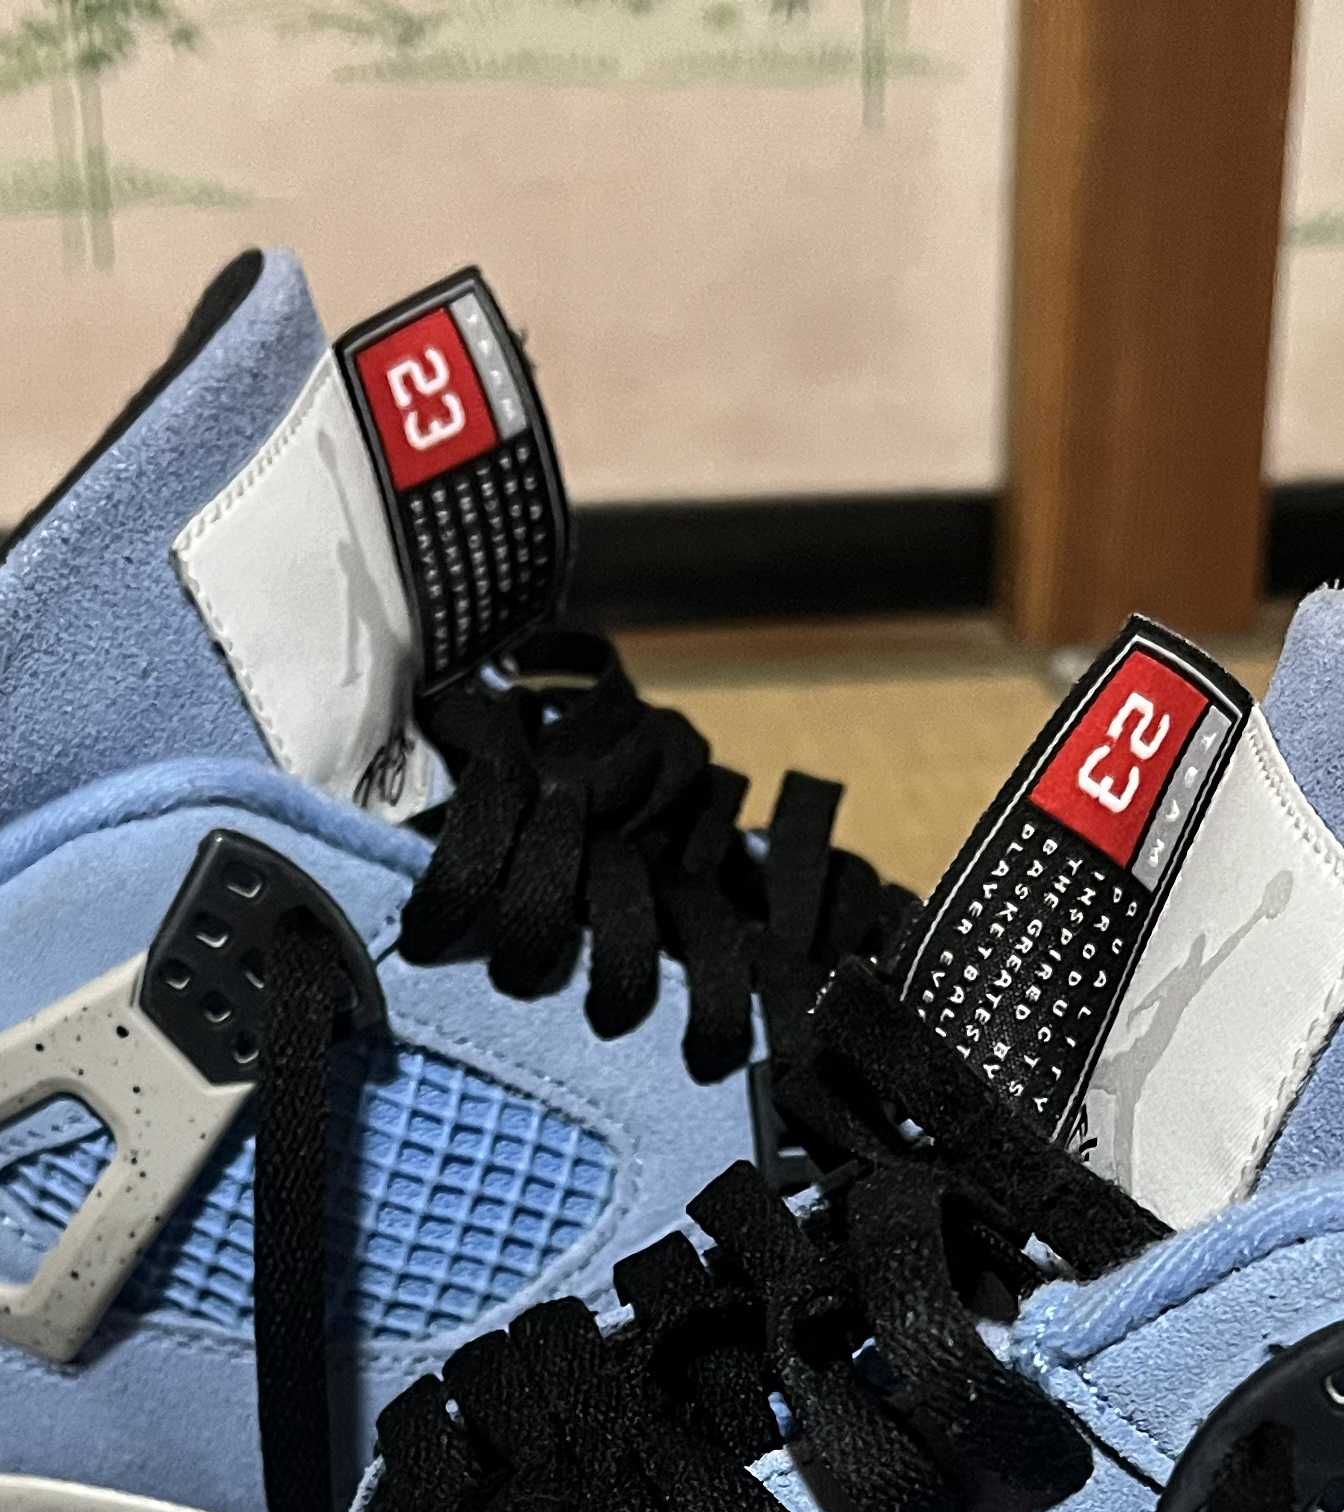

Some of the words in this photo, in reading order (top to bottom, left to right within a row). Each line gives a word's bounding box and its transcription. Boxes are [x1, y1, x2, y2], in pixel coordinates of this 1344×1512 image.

[386, 349, 464, 450] 23
[1076, 690, 1168, 814] 23
[954, 823, 1033, 935] PLAYER
[1043, 857, 1082, 910] THE
[955, 919, 1040, 1059] GREATEST
[1009, 886, 1122, 1094] PRODUCTS
[1014, 873, 1104, 1019] INSPIRED
[1032, 903, 1138, 1111] QUALITY
[982, 1042, 1010, 1079] BY
